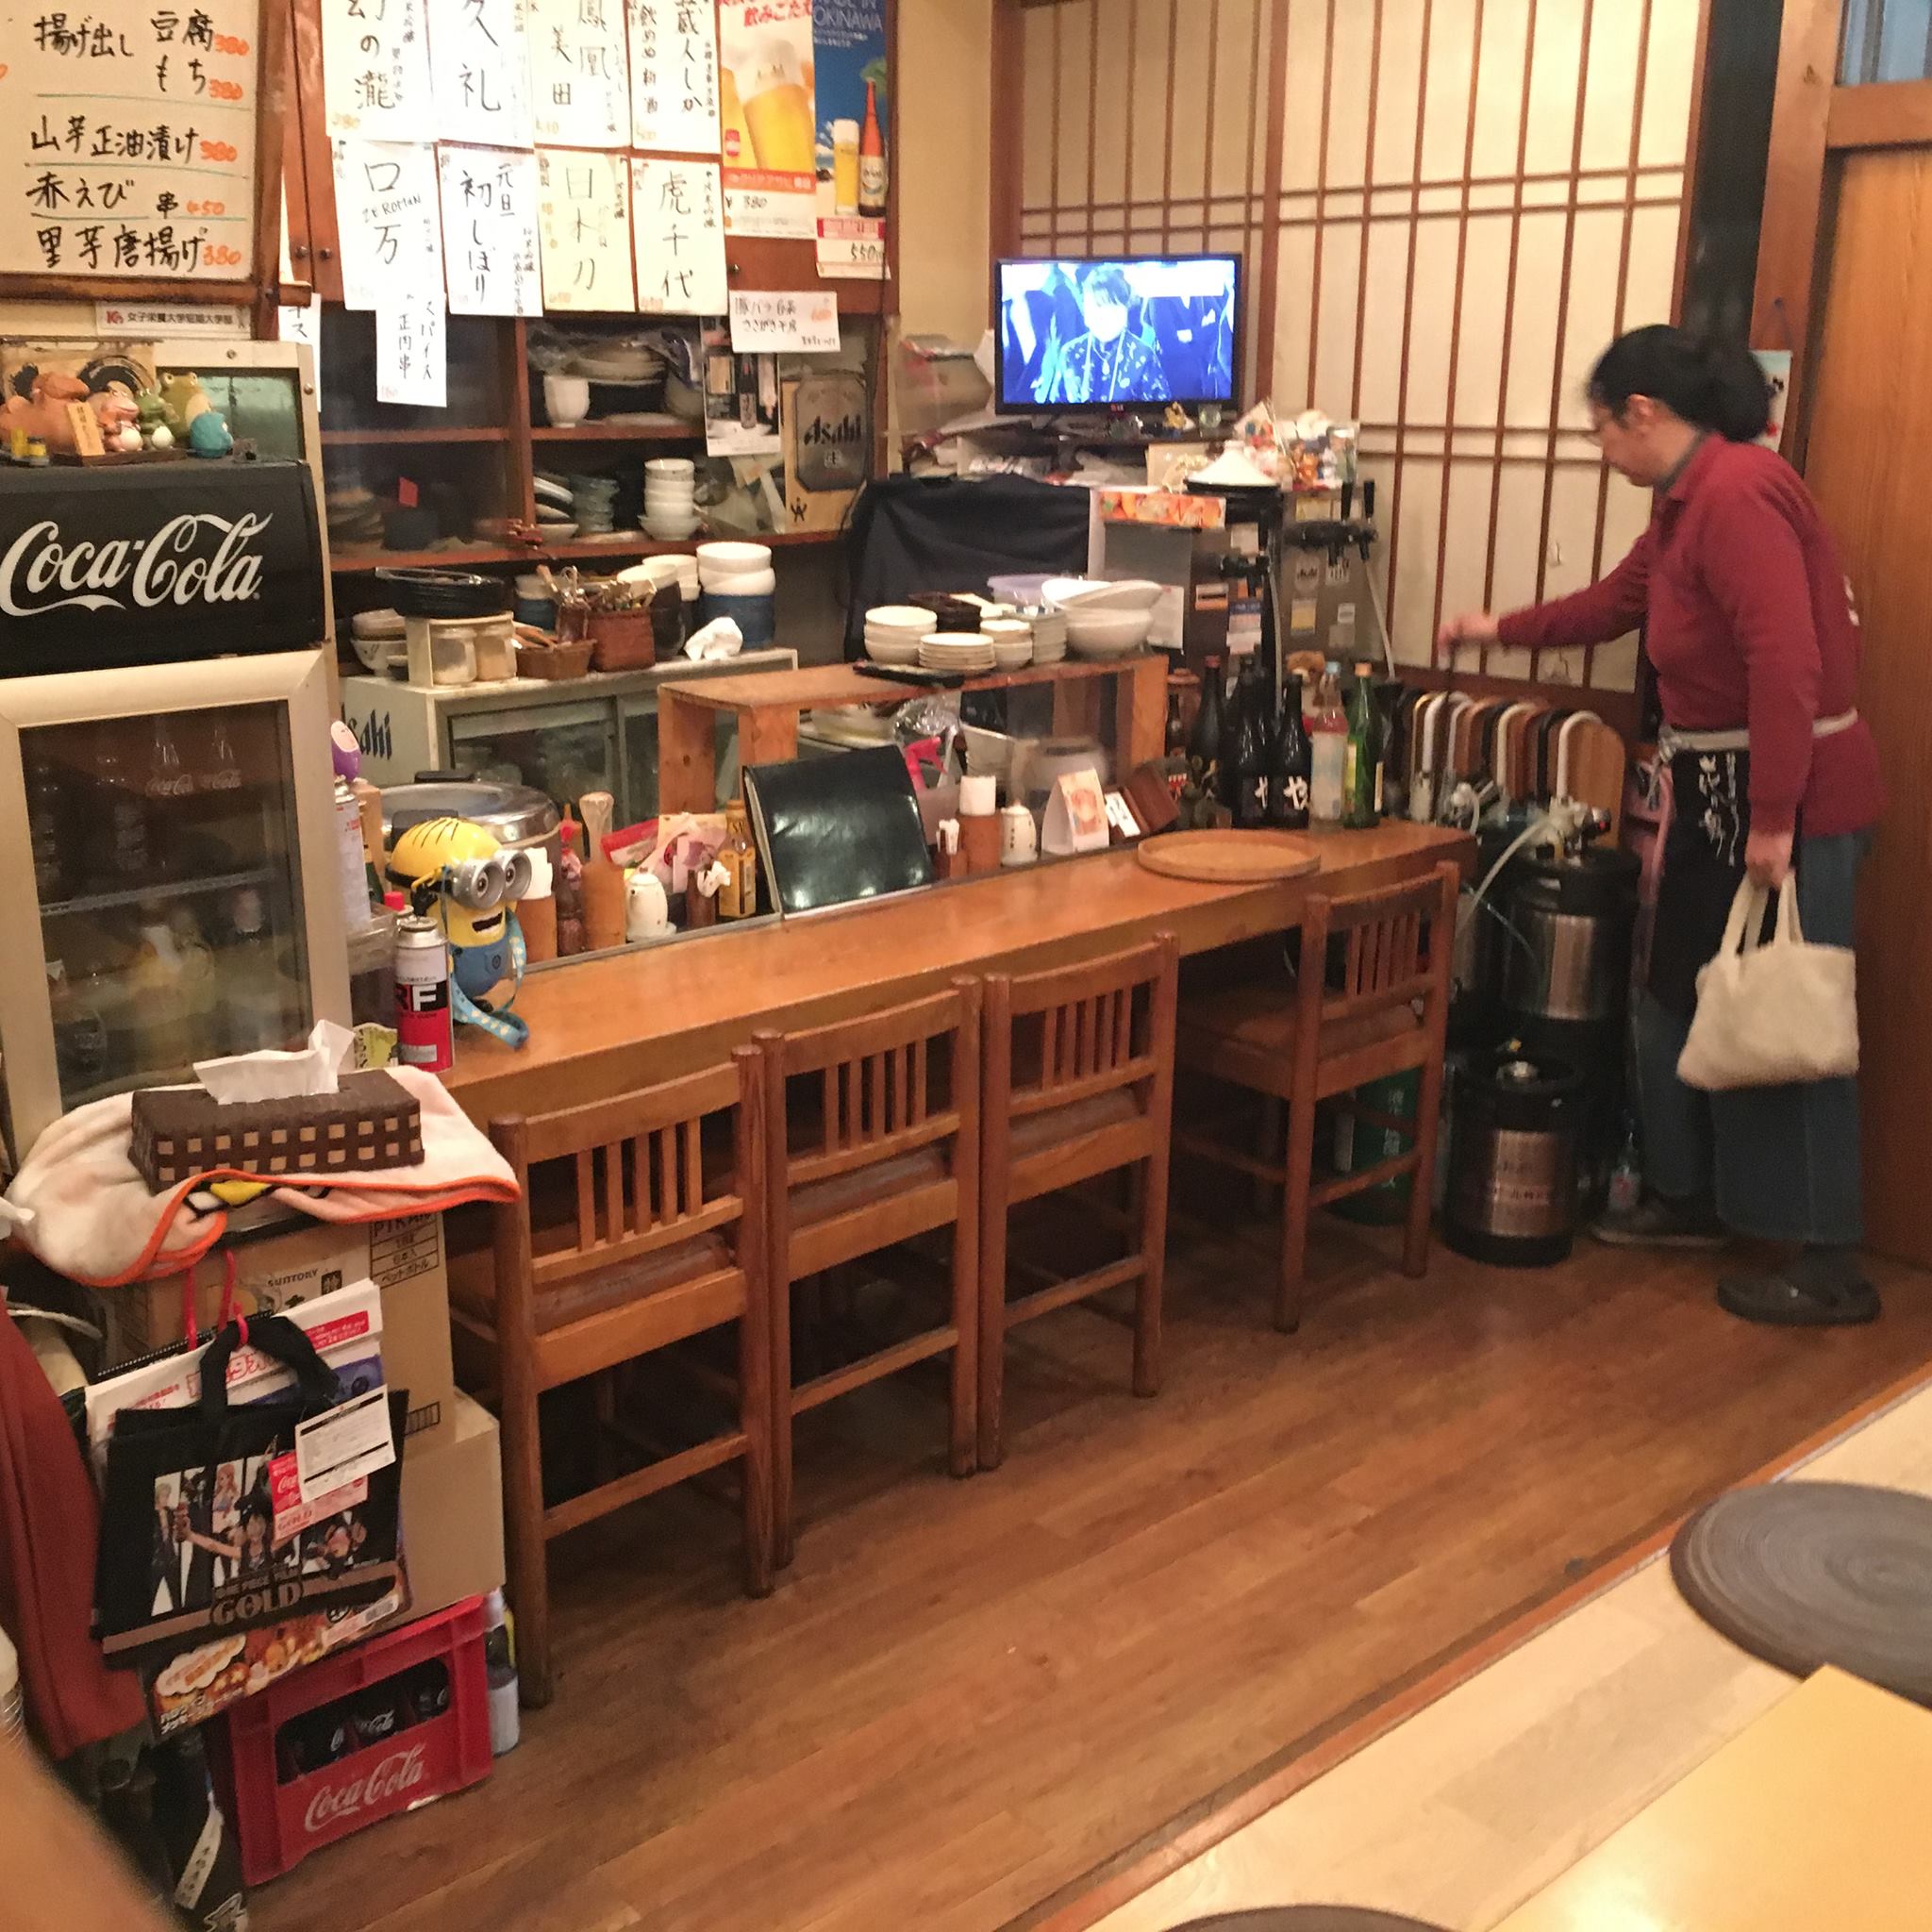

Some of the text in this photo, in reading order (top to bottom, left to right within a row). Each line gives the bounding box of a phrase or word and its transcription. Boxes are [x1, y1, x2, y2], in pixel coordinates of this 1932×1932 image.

[34, 13, 134, 58] 揚げ出し
[25, 172, 135, 210] 赤えび
[804, 413, 862, 447] Asahi
[0, 512, 274, 616] Coca-Cola
[212, 1582, 303, 1625] GOLD
